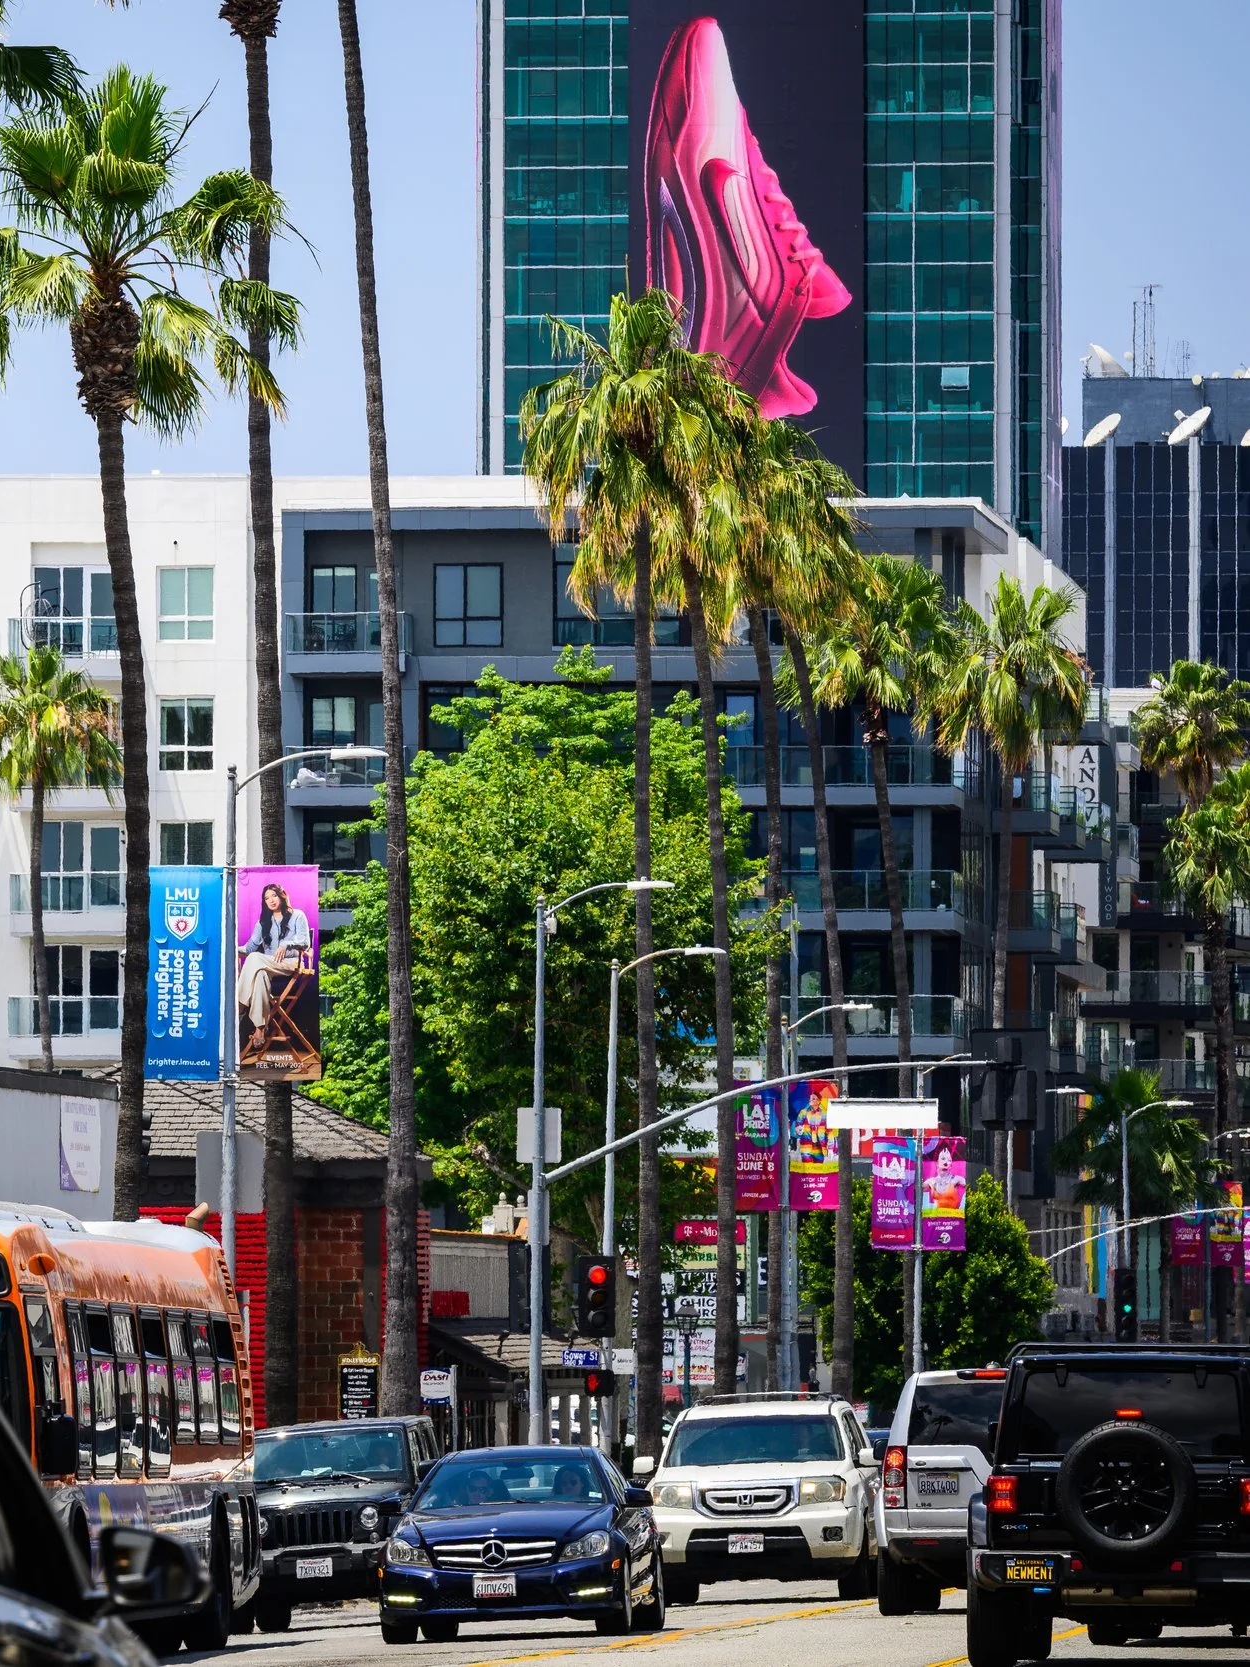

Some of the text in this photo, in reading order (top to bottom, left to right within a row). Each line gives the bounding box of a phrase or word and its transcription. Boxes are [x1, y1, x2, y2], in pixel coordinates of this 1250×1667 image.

[165, 887, 200, 900] LMU
[154, 949, 174, 1021] brighter.
[186, 950, 204, 1029] Believe in
[168, 949, 189, 1038] something
[147, 1058, 211, 1067] brighter.lmu.edu
[743, 1120, 770, 1129] PRIDE
[737, 1152, 775, 1161] SUNDAY
[736, 1161, 775, 1171] JUNE 8
[877, 1198, 909, 1208] SUNDAY
[877, 1207, 901, 1216] JUNE
[564, 1350, 598, 1361] Gower St
[1006, 1566, 1054, 1580] NEWMENT
